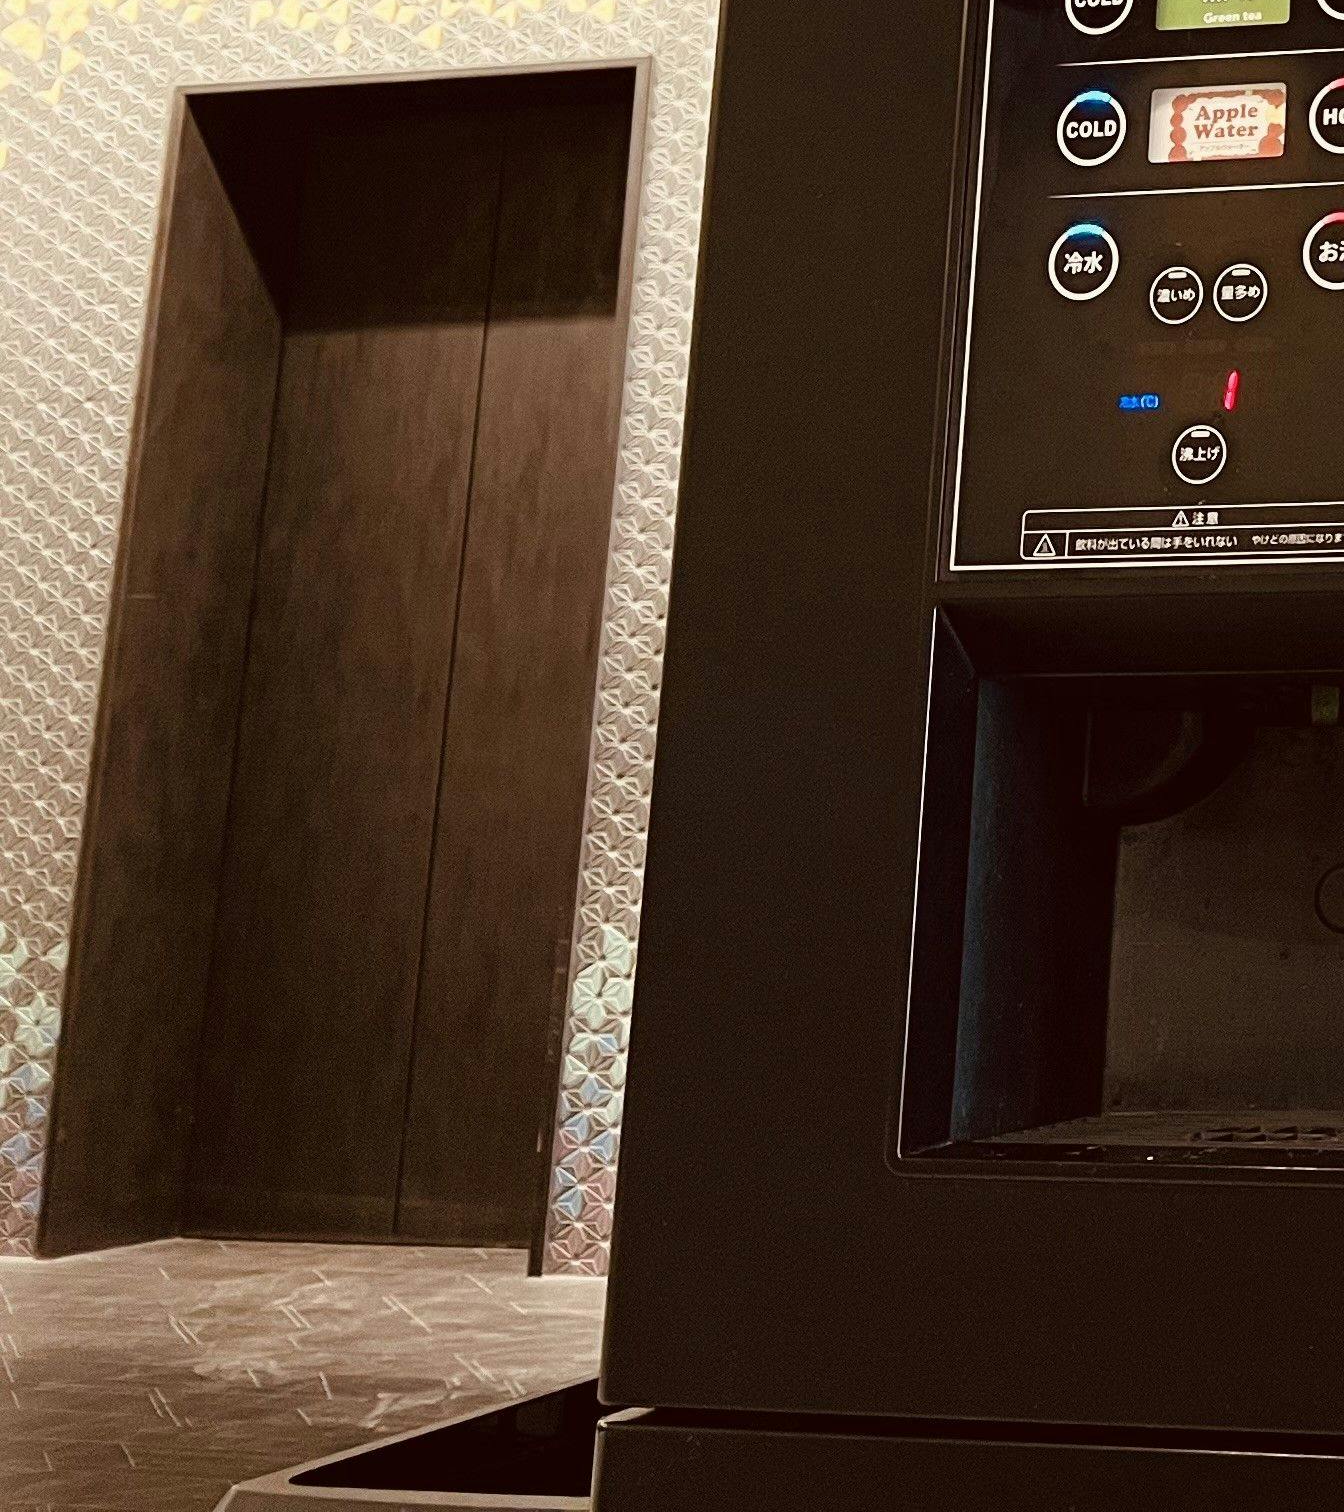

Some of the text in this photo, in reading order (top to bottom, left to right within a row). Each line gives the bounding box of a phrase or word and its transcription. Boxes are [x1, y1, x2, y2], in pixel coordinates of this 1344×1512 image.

[1202, 10, 1263, 24] Green tea
[1194, 103, 1258, 124] Apple
[1066, 119, 1117, 138] COLD
[1193, 124, 1259, 139] Water
[1063, 251, 1104, 275] 冷水
[1157, 287, 1196, 304] 濃いめ
